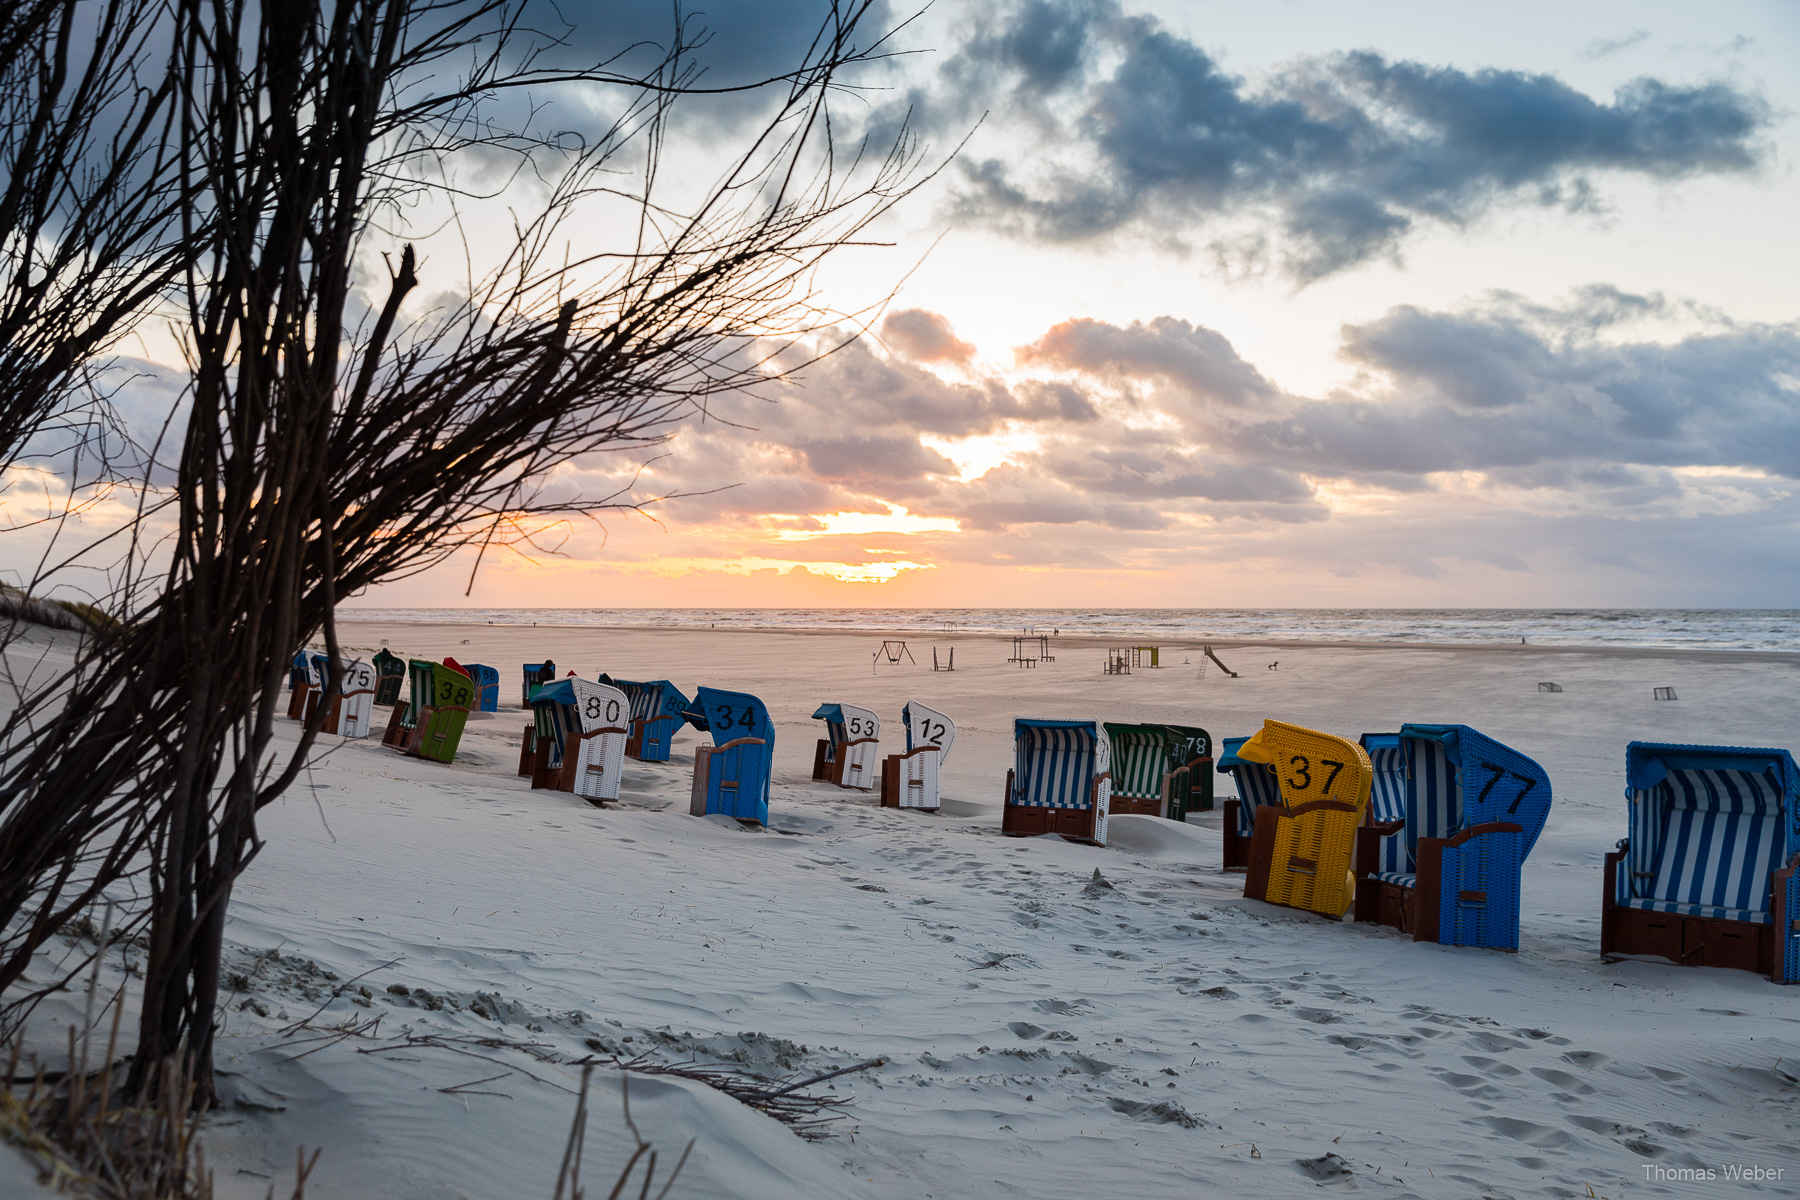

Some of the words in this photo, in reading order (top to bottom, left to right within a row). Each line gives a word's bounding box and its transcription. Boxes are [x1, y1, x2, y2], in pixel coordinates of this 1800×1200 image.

[345, 669, 370, 687] 75
[482, 669, 496, 681] 56
[440, 681, 468, 705] 38
[585, 696, 620, 723] 80
[716, 705, 756, 731] 34
[850, 717, 875, 737] 53
[921, 718, 946, 745] 12
[1186, 737, 1207, 755] 78
[1287, 755, 1344, 795] 37
[1478, 761, 1537, 815] 77
